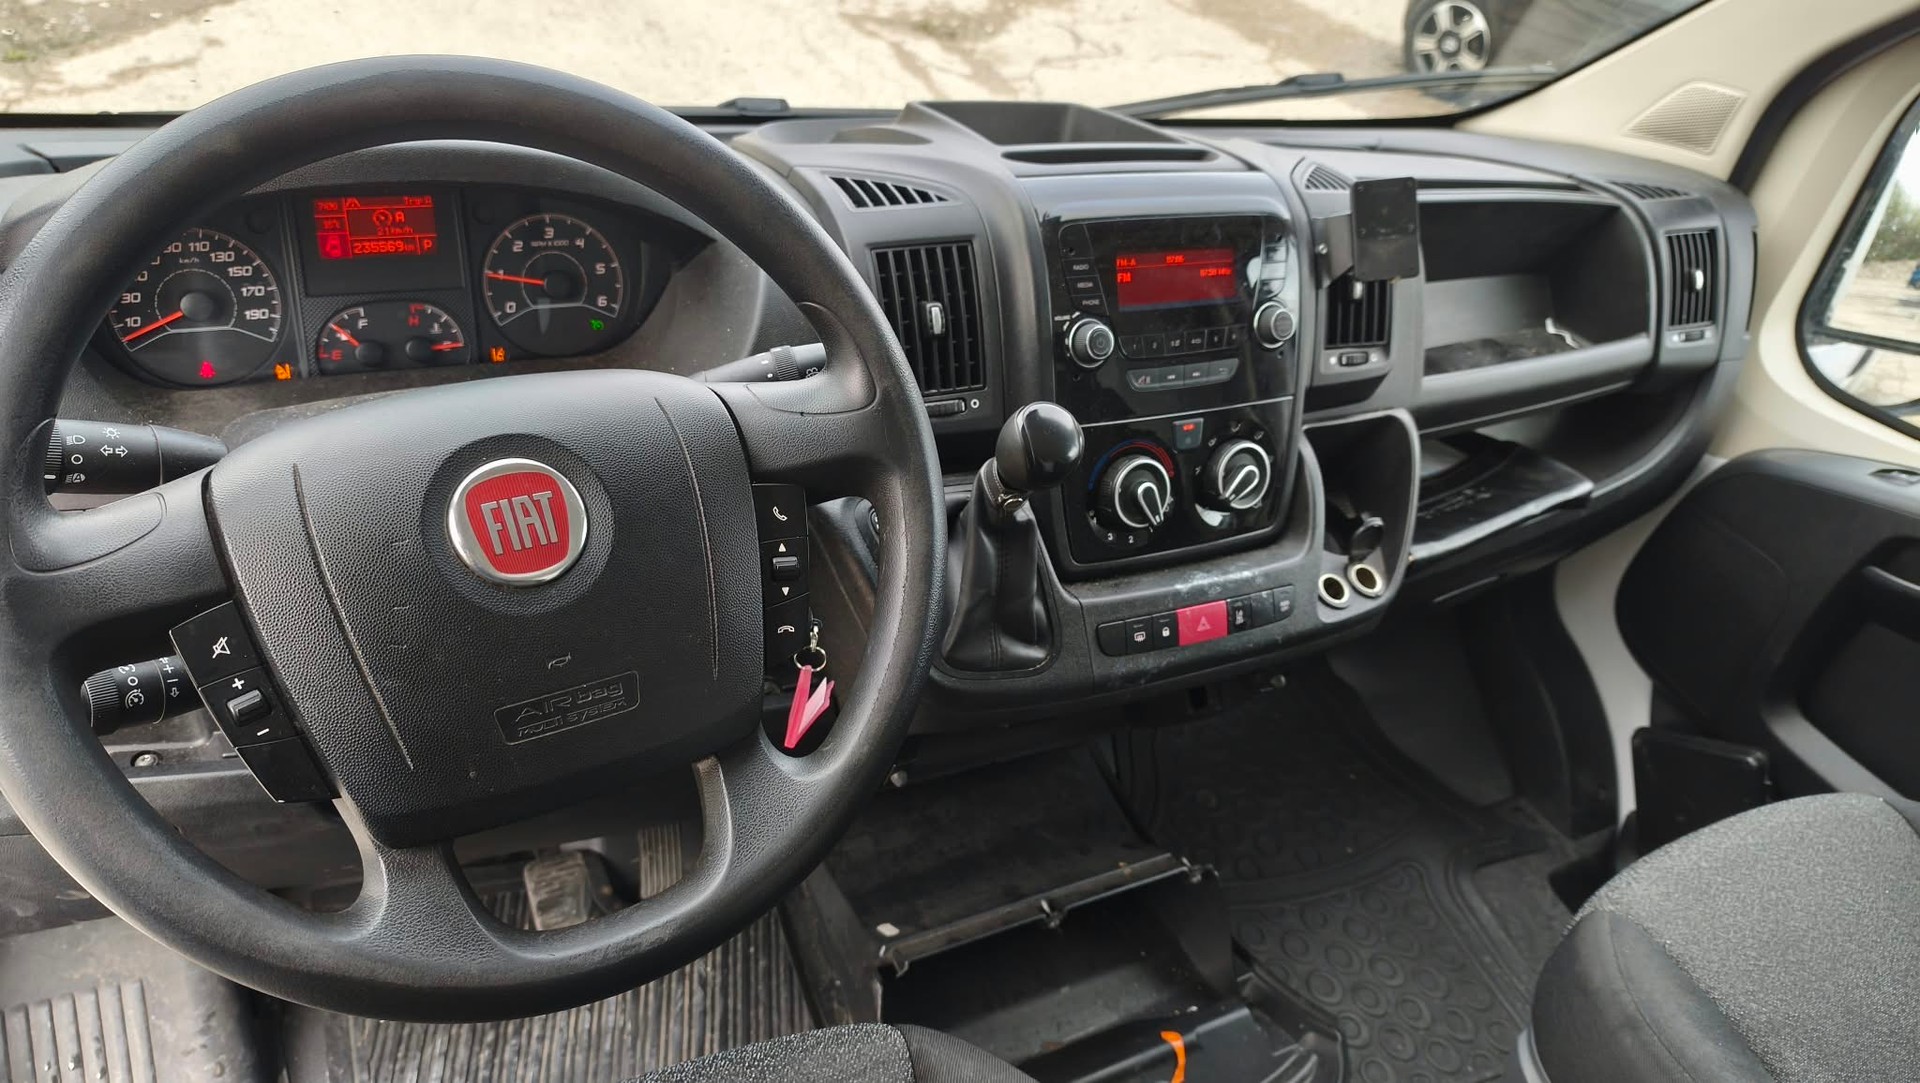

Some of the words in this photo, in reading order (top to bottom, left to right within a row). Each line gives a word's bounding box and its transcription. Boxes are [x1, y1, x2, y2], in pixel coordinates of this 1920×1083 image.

[544, 227, 554, 239] 3
[188, 241, 210, 252] 110
[512, 241, 523, 252] 2
[575, 238, 585, 248] 4
[179, 256, 200, 265] km/h
[209, 252, 235, 262] 130
[227, 266, 253, 277] 150
[595, 263, 606, 274] 5
[1117, 272, 1132, 283] FM
[240, 285, 266, 297] 170
[120, 292, 141, 303] 30
[597, 296, 608, 307] 6
[506, 301, 517, 314] 0
[243, 309, 270, 320] 190
[124, 317, 141, 327] 10
[357, 318, 368, 330] F
[408, 315, 420, 327] H
[331, 349, 344, 361] E
[481, 490, 559, 555] FIAT
[1107, 532, 1113, 541] 3
[1128, 535, 1134, 544] 2
